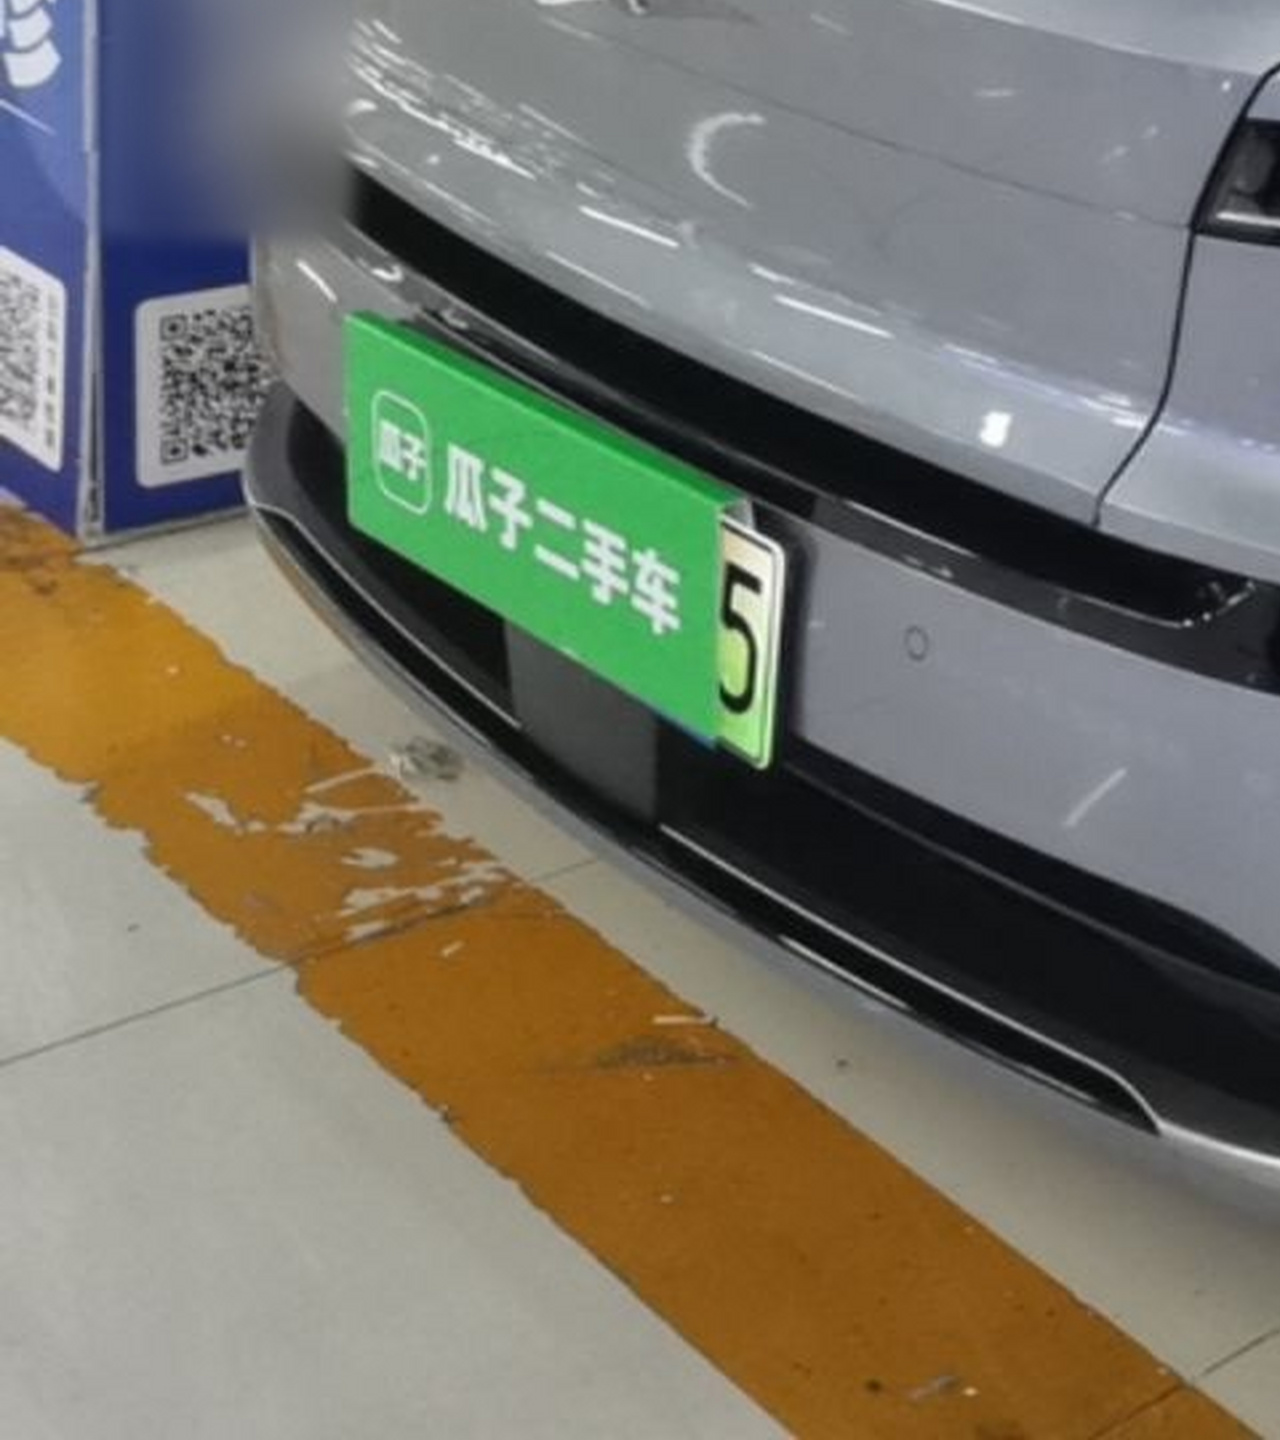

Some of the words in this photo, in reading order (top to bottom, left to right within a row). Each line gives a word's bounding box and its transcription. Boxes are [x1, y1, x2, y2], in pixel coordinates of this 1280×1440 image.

[443, 441, 681, 637] 瓜子二手车
